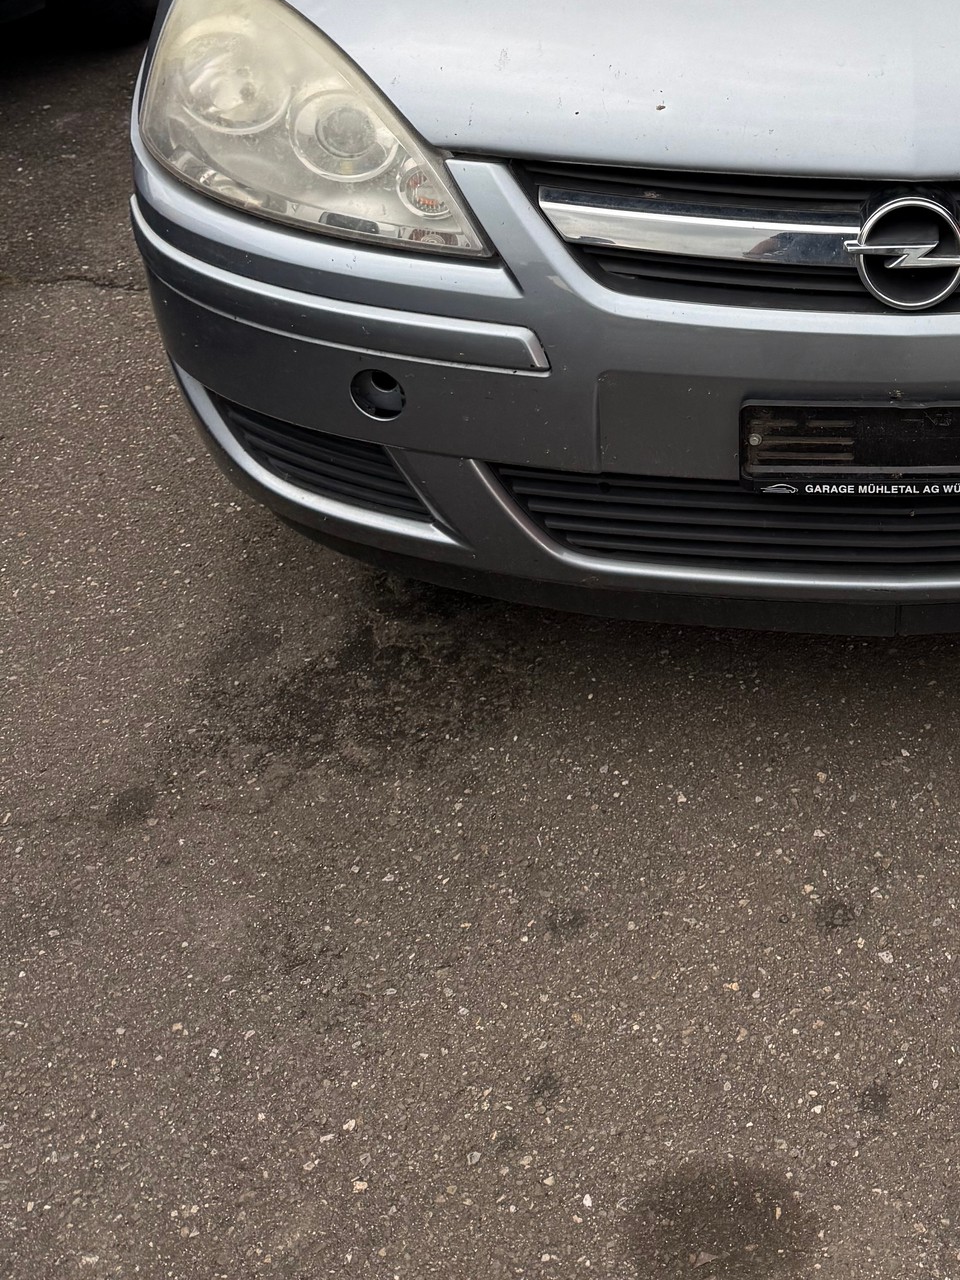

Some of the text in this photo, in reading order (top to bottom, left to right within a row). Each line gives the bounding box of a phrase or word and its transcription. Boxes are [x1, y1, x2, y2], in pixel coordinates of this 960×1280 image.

[805, 484, 855, 494] GARAGE
[858, 483, 920, 494] MÜHLETAL
[922, 484, 940, 494] AG
